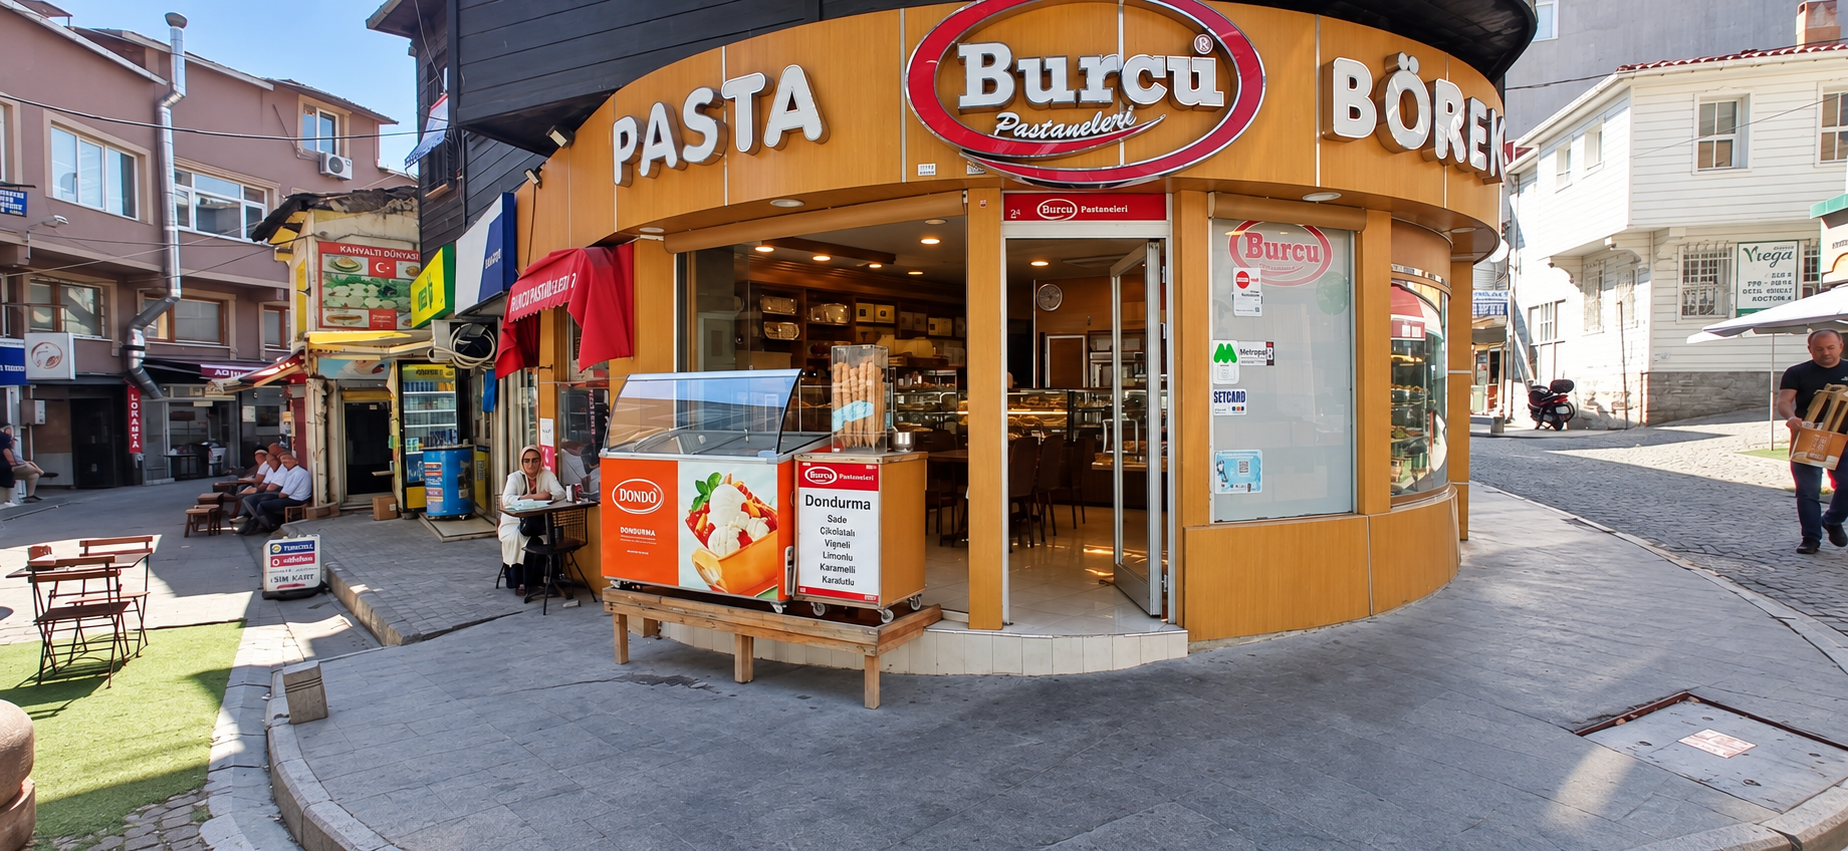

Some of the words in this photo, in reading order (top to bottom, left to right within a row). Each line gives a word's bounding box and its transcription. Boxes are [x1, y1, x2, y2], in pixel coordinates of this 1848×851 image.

[957, 42, 1225, 113] Burcu
[612, 64, 830, 187] PASTA
[993, 105, 1137, 139] Pastaneleri
[1323, 51, 1506, 186] BÖREK
[1042, 205, 1073, 214] Burcu
[340, 245, 382, 257] KAHVALTI
[383, 250, 419, 260] DÜNYASI
[1244, 231, 1320, 263] Burcu
[1213, 390, 1246, 404] SETCARD
[805, 494, 871, 511] Dondurma
[827, 514, 848, 524] Sade
[620, 526, 656, 537] DONDURMA
[822, 551, 854, 562] Limonlu
[819, 563, 856, 574] Karamelli
